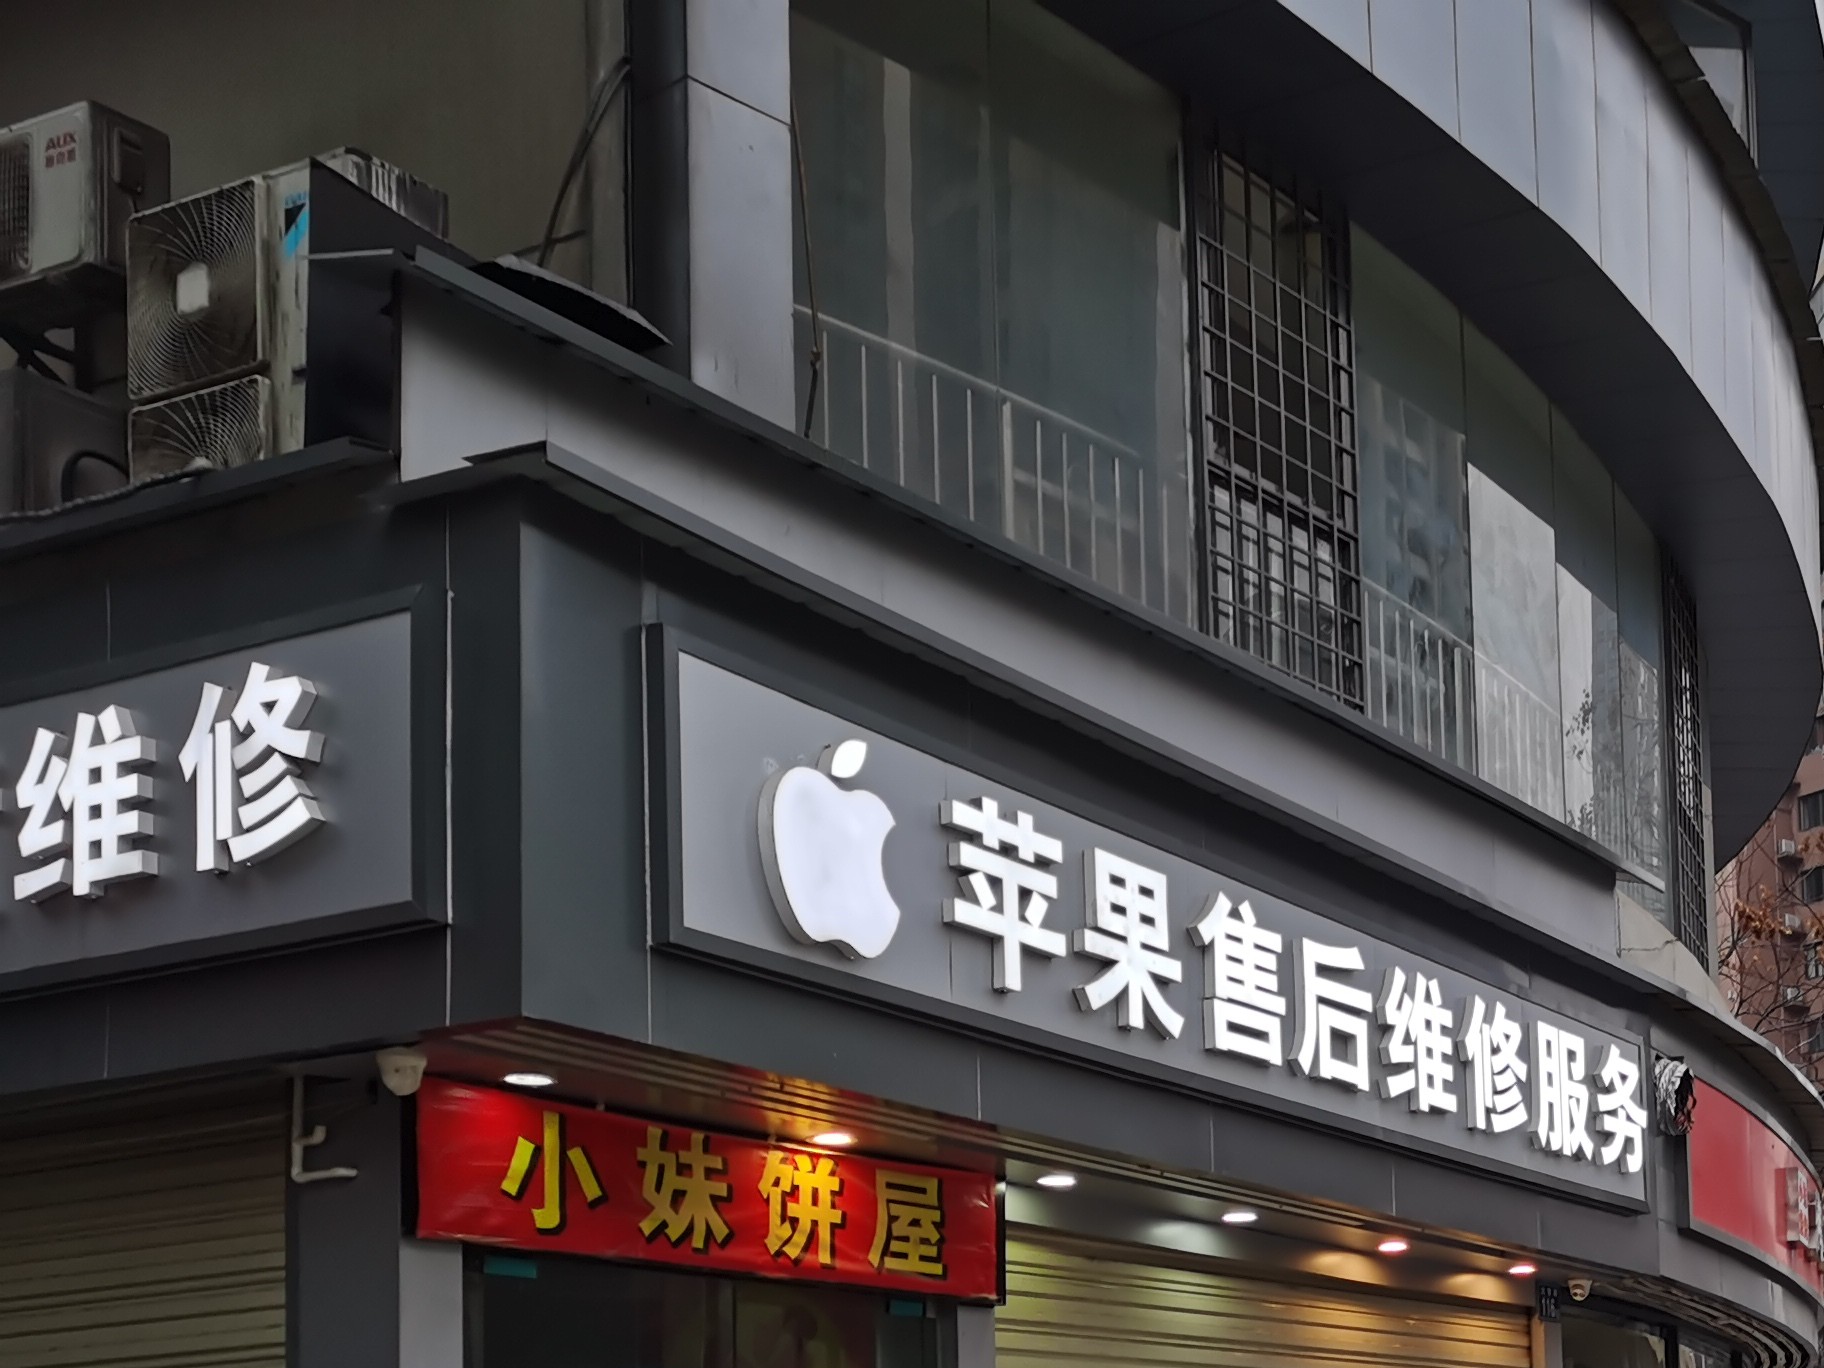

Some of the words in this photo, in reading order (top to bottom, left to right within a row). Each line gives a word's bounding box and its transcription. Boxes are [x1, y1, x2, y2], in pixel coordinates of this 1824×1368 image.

[45, 132, 77, 152] AUX
[14, 661, 326, 903] 维修
[942, 796, 1648, 1174] 苹果售后维修服务
[500, 1111, 946, 1279] 小妹饼屋
